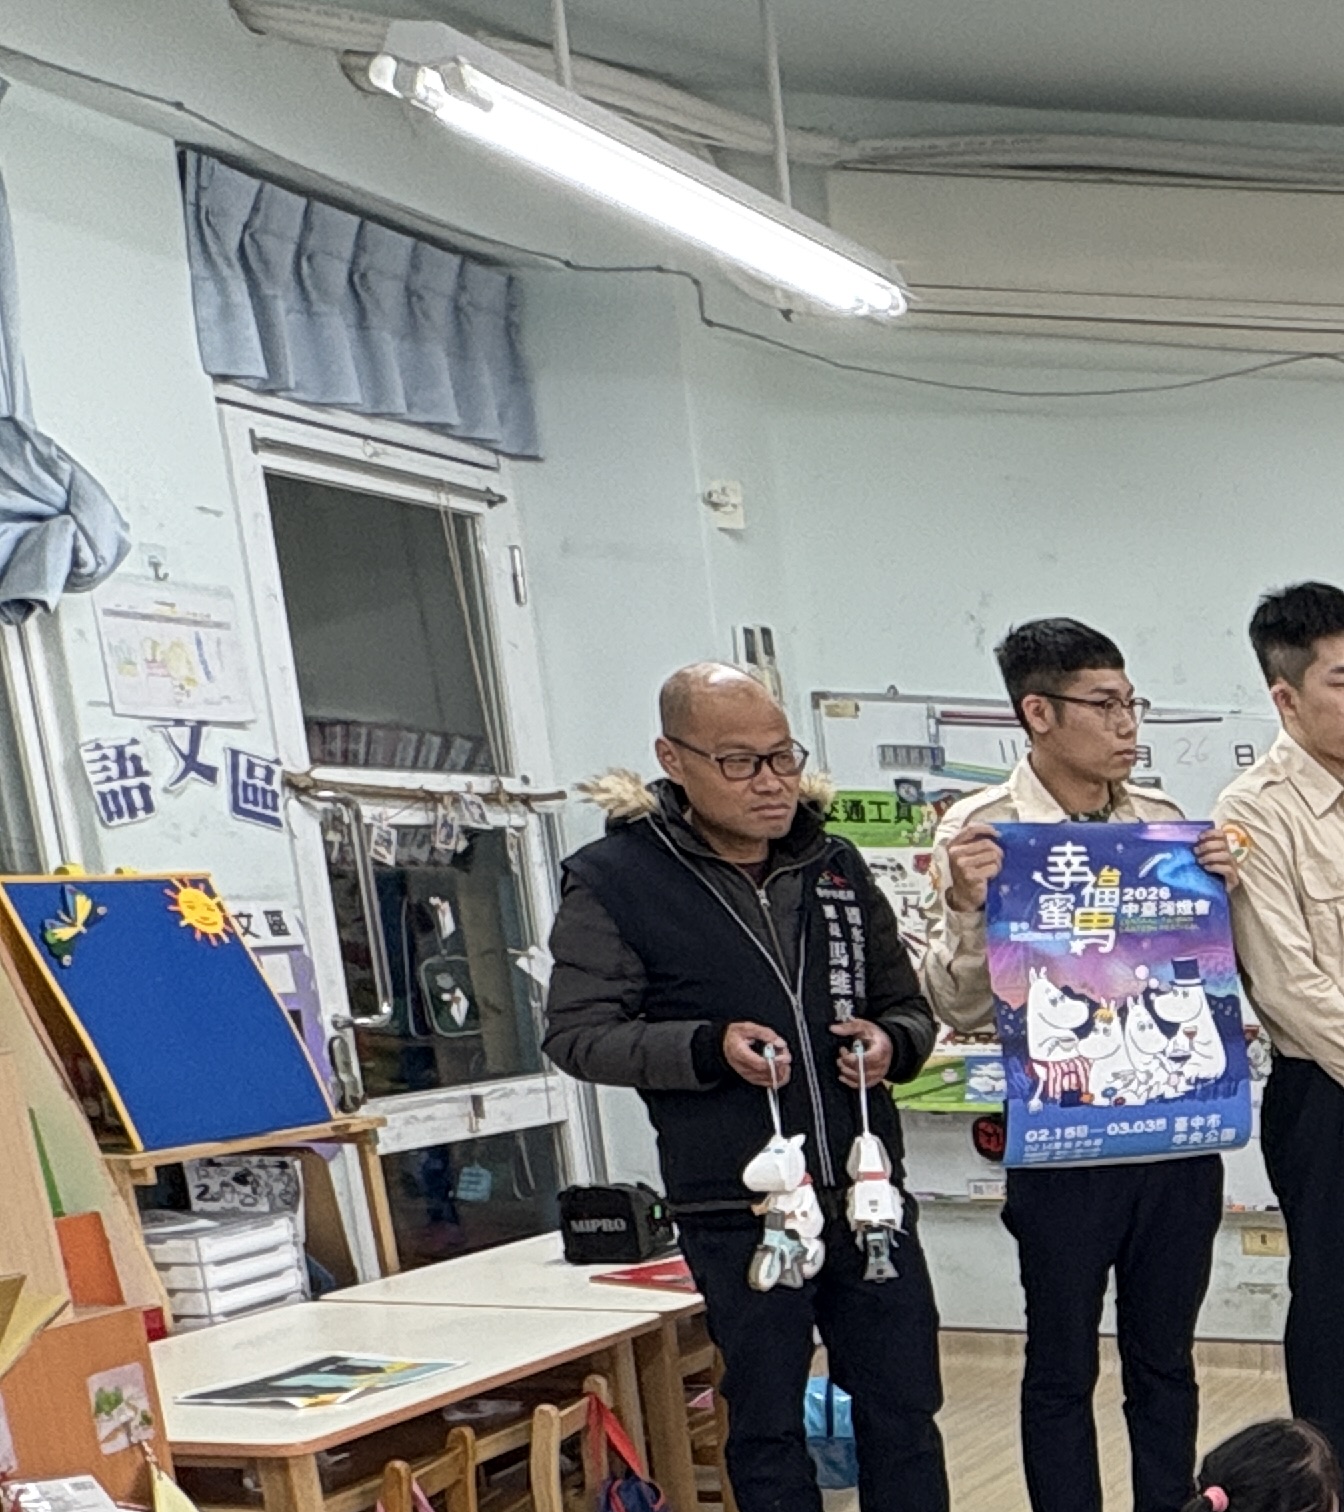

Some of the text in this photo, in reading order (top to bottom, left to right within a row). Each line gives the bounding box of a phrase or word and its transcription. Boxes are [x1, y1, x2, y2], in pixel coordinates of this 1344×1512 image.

[1234, 743, 1256, 768] 日
[84, 718, 283, 828] 語文區
[570, 1218, 626, 1233] MIPRO
